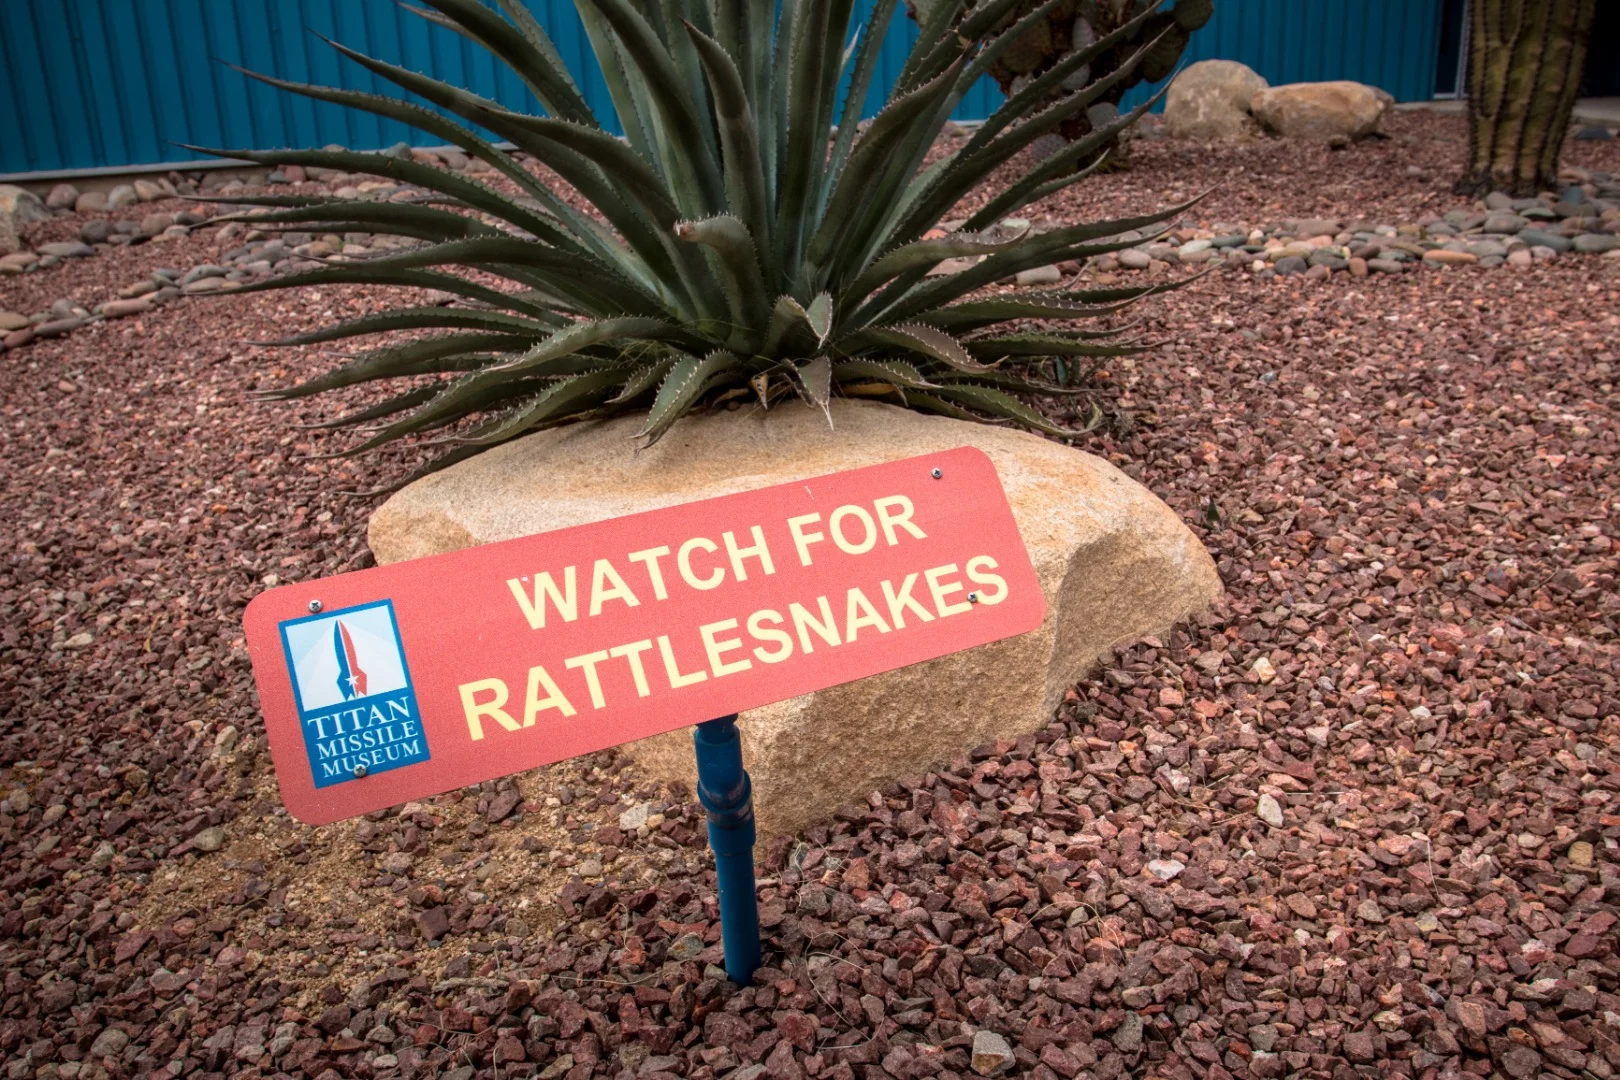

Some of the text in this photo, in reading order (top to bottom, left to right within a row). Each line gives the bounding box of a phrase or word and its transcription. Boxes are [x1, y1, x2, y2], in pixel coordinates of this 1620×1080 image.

[506, 494, 928, 630] WATCH FOR
[457, 554, 1009, 741] RATTLESNAKES
[307, 697, 411, 740] TITAN
[316, 721, 418, 760] MISSILE
[321, 740, 422, 778] MUSEUM
